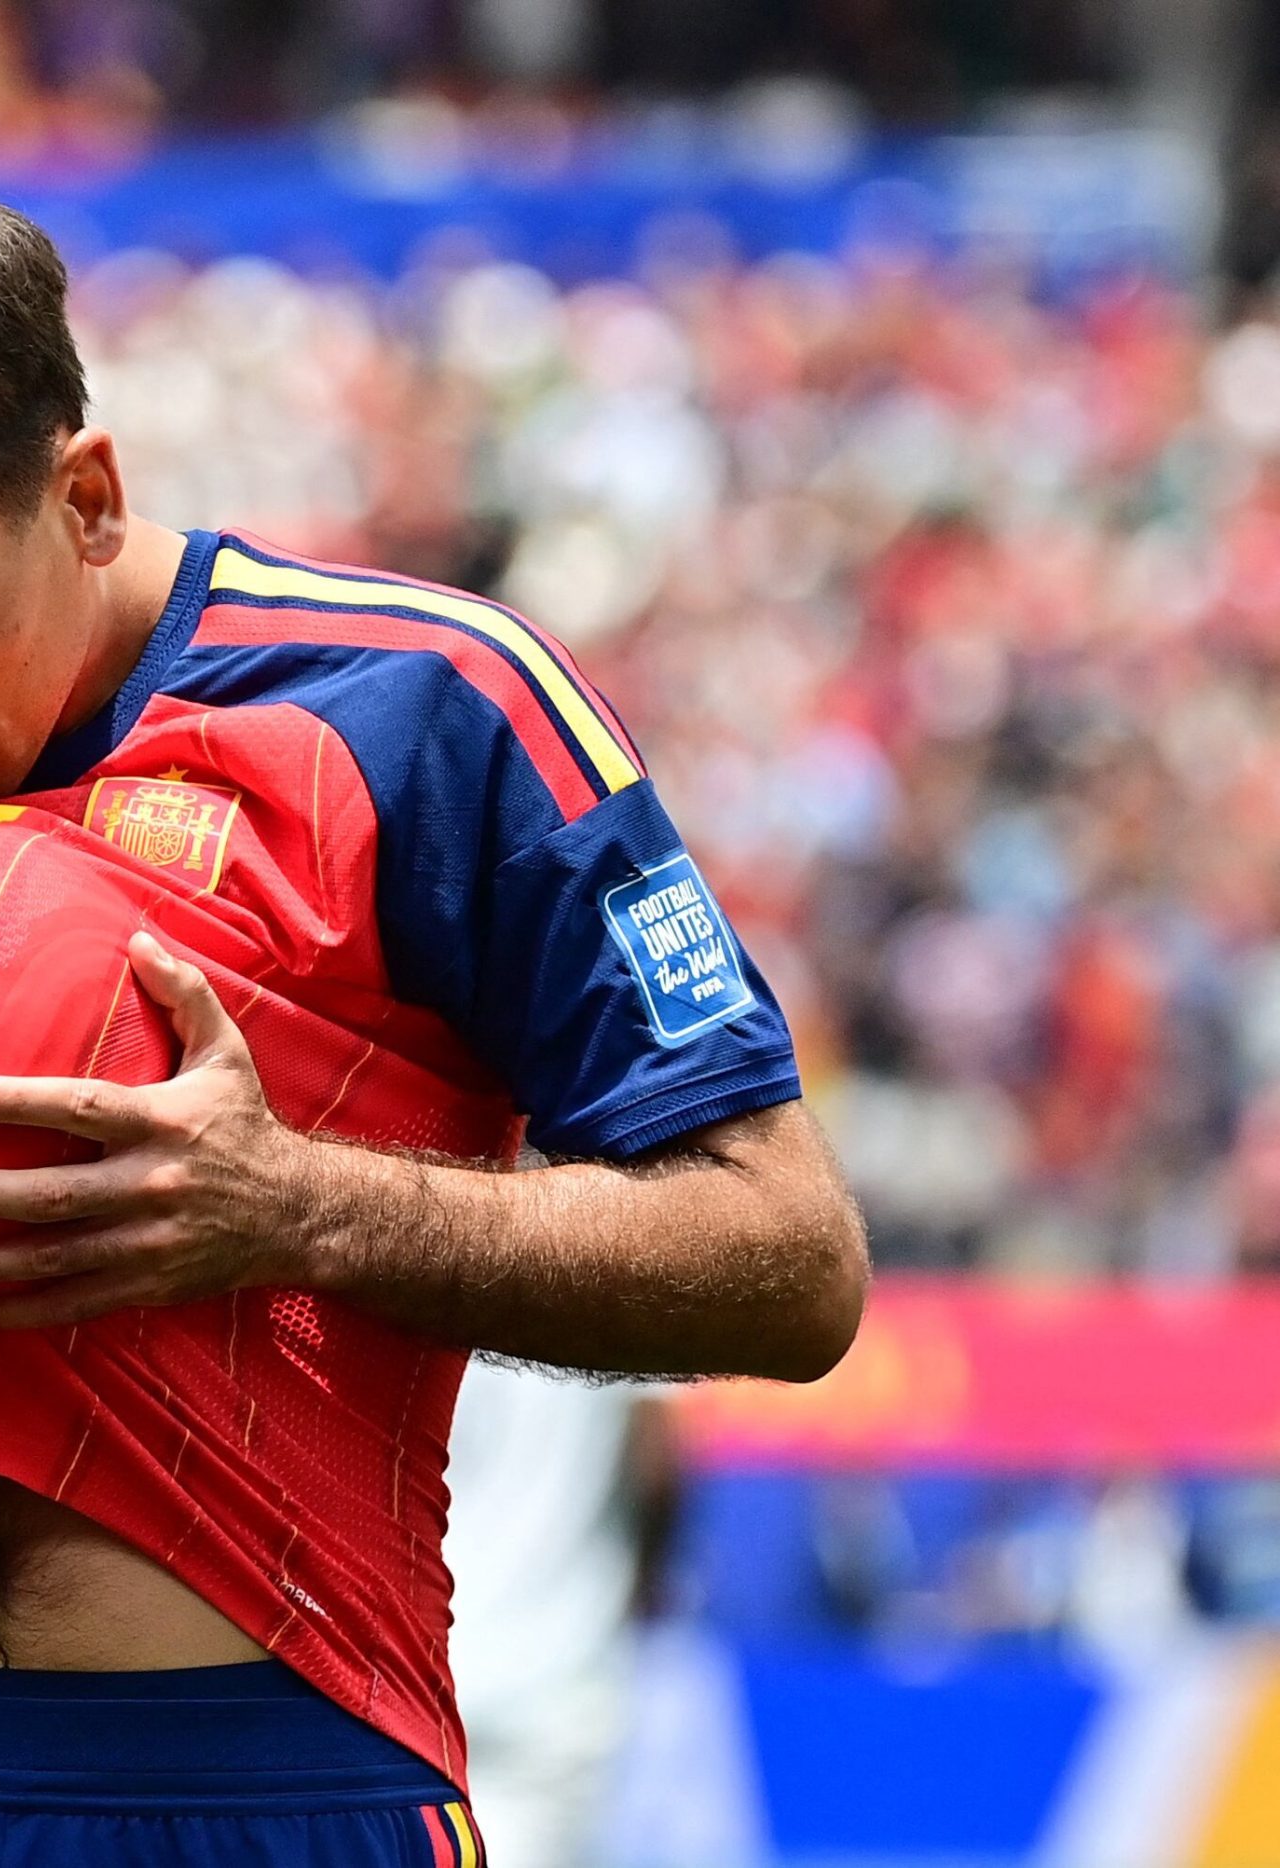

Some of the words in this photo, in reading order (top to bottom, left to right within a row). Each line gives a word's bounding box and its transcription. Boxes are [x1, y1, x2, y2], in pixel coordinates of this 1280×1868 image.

[628, 878, 700, 929] FOOTBALL
[640, 902, 714, 961] UNITES
[654, 961, 689, 994] the
[691, 976, 725, 1002] FIFA
